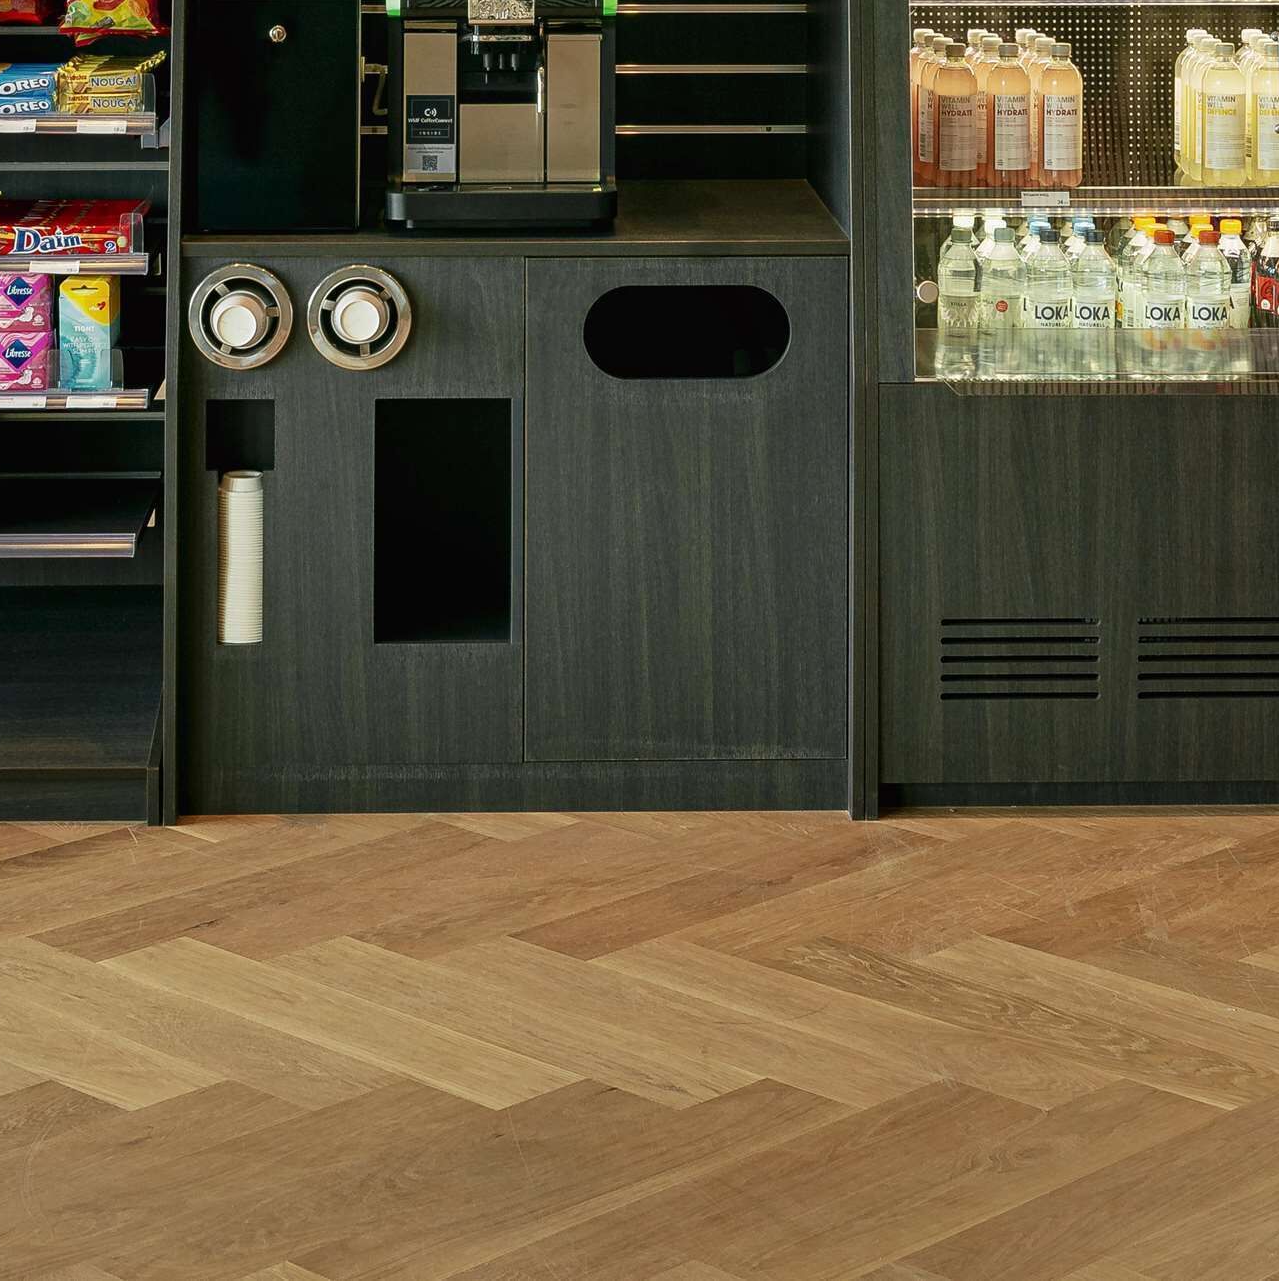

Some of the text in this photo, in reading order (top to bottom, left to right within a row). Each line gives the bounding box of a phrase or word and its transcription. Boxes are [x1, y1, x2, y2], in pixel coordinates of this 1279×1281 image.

[91, 76, 136, 87] NOUGAT
[93, 98, 138, 108] NOUGAT
[13, 227, 82, 253] Daim
[105, 241, 116, 253] 2
[7, 286, 35, 297] Libresse
[1035, 305, 1068, 320] LOKA
[1075, 305, 1110, 321] LOKA
[1145, 306, 1180, 321] LOKA
[1192, 306, 1228, 321] LOKA
[5, 347, 33, 358] Libresse
